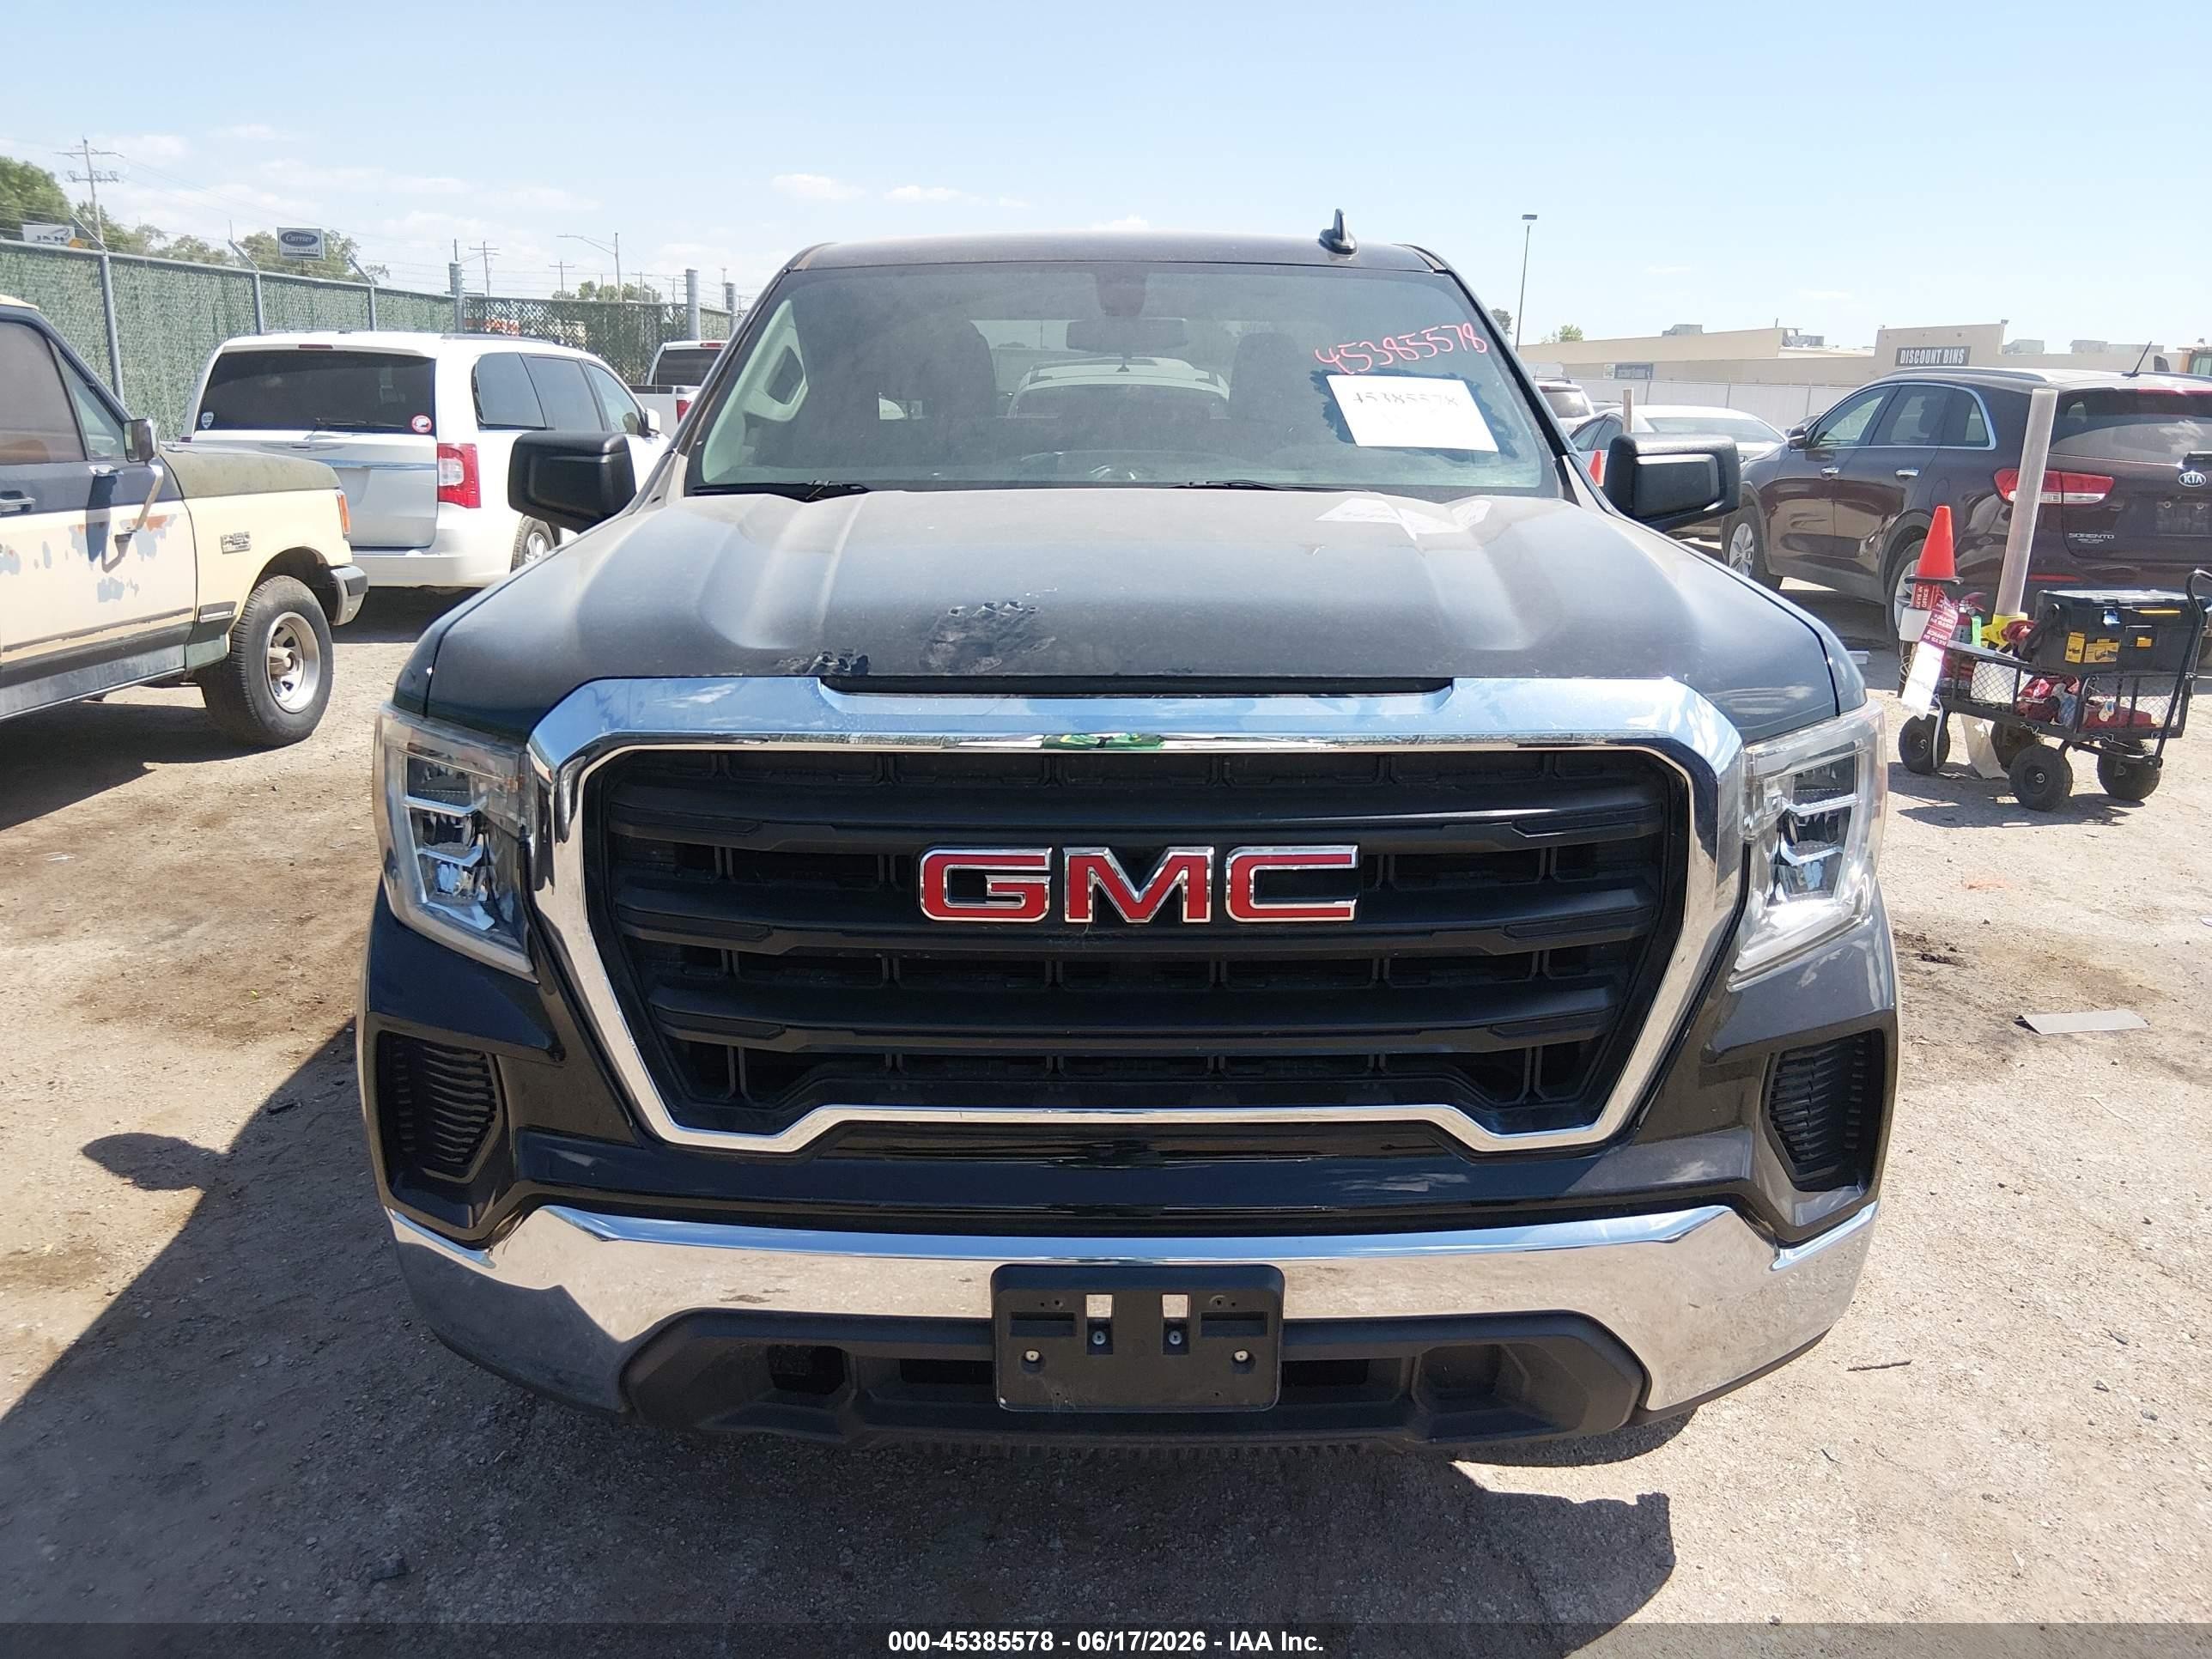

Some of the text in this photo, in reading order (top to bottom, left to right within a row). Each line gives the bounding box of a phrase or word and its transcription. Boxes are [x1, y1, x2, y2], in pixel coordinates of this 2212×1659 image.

[1315, 323, 1487, 374] 45385578
[1899, 348, 1965, 364] DISCOUNT BINS
[2183, 475, 2203, 483] KIA
[920, 846, 1359, 924] GMC
